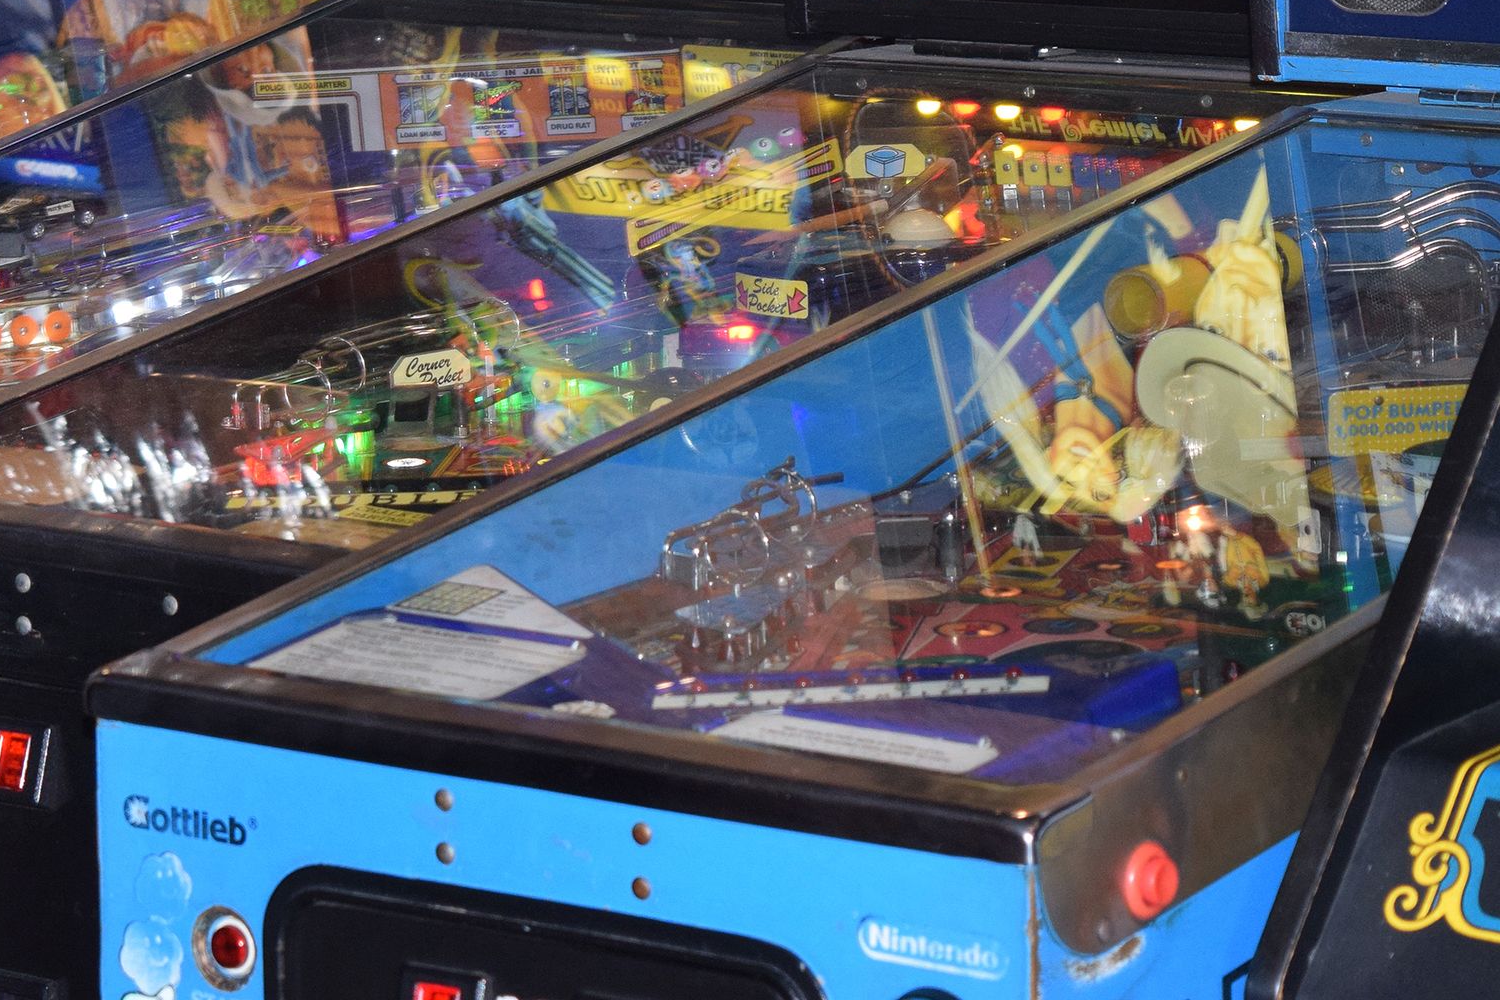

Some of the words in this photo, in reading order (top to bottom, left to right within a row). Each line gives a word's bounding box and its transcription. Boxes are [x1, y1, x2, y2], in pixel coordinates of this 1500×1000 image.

[550, 122, 574, 131] DRUG
[575, 121, 592, 130] RAT
[753, 278, 781, 296] Side
[748, 294, 789, 315] Pocket
[404, 356, 453, 379] Corner
[419, 367, 465, 386] Pocket
[1342, 403, 1384, 422] POP
[123, 793, 248, 847] Gottlieb
[868, 921, 1000, 969] Nintendo
